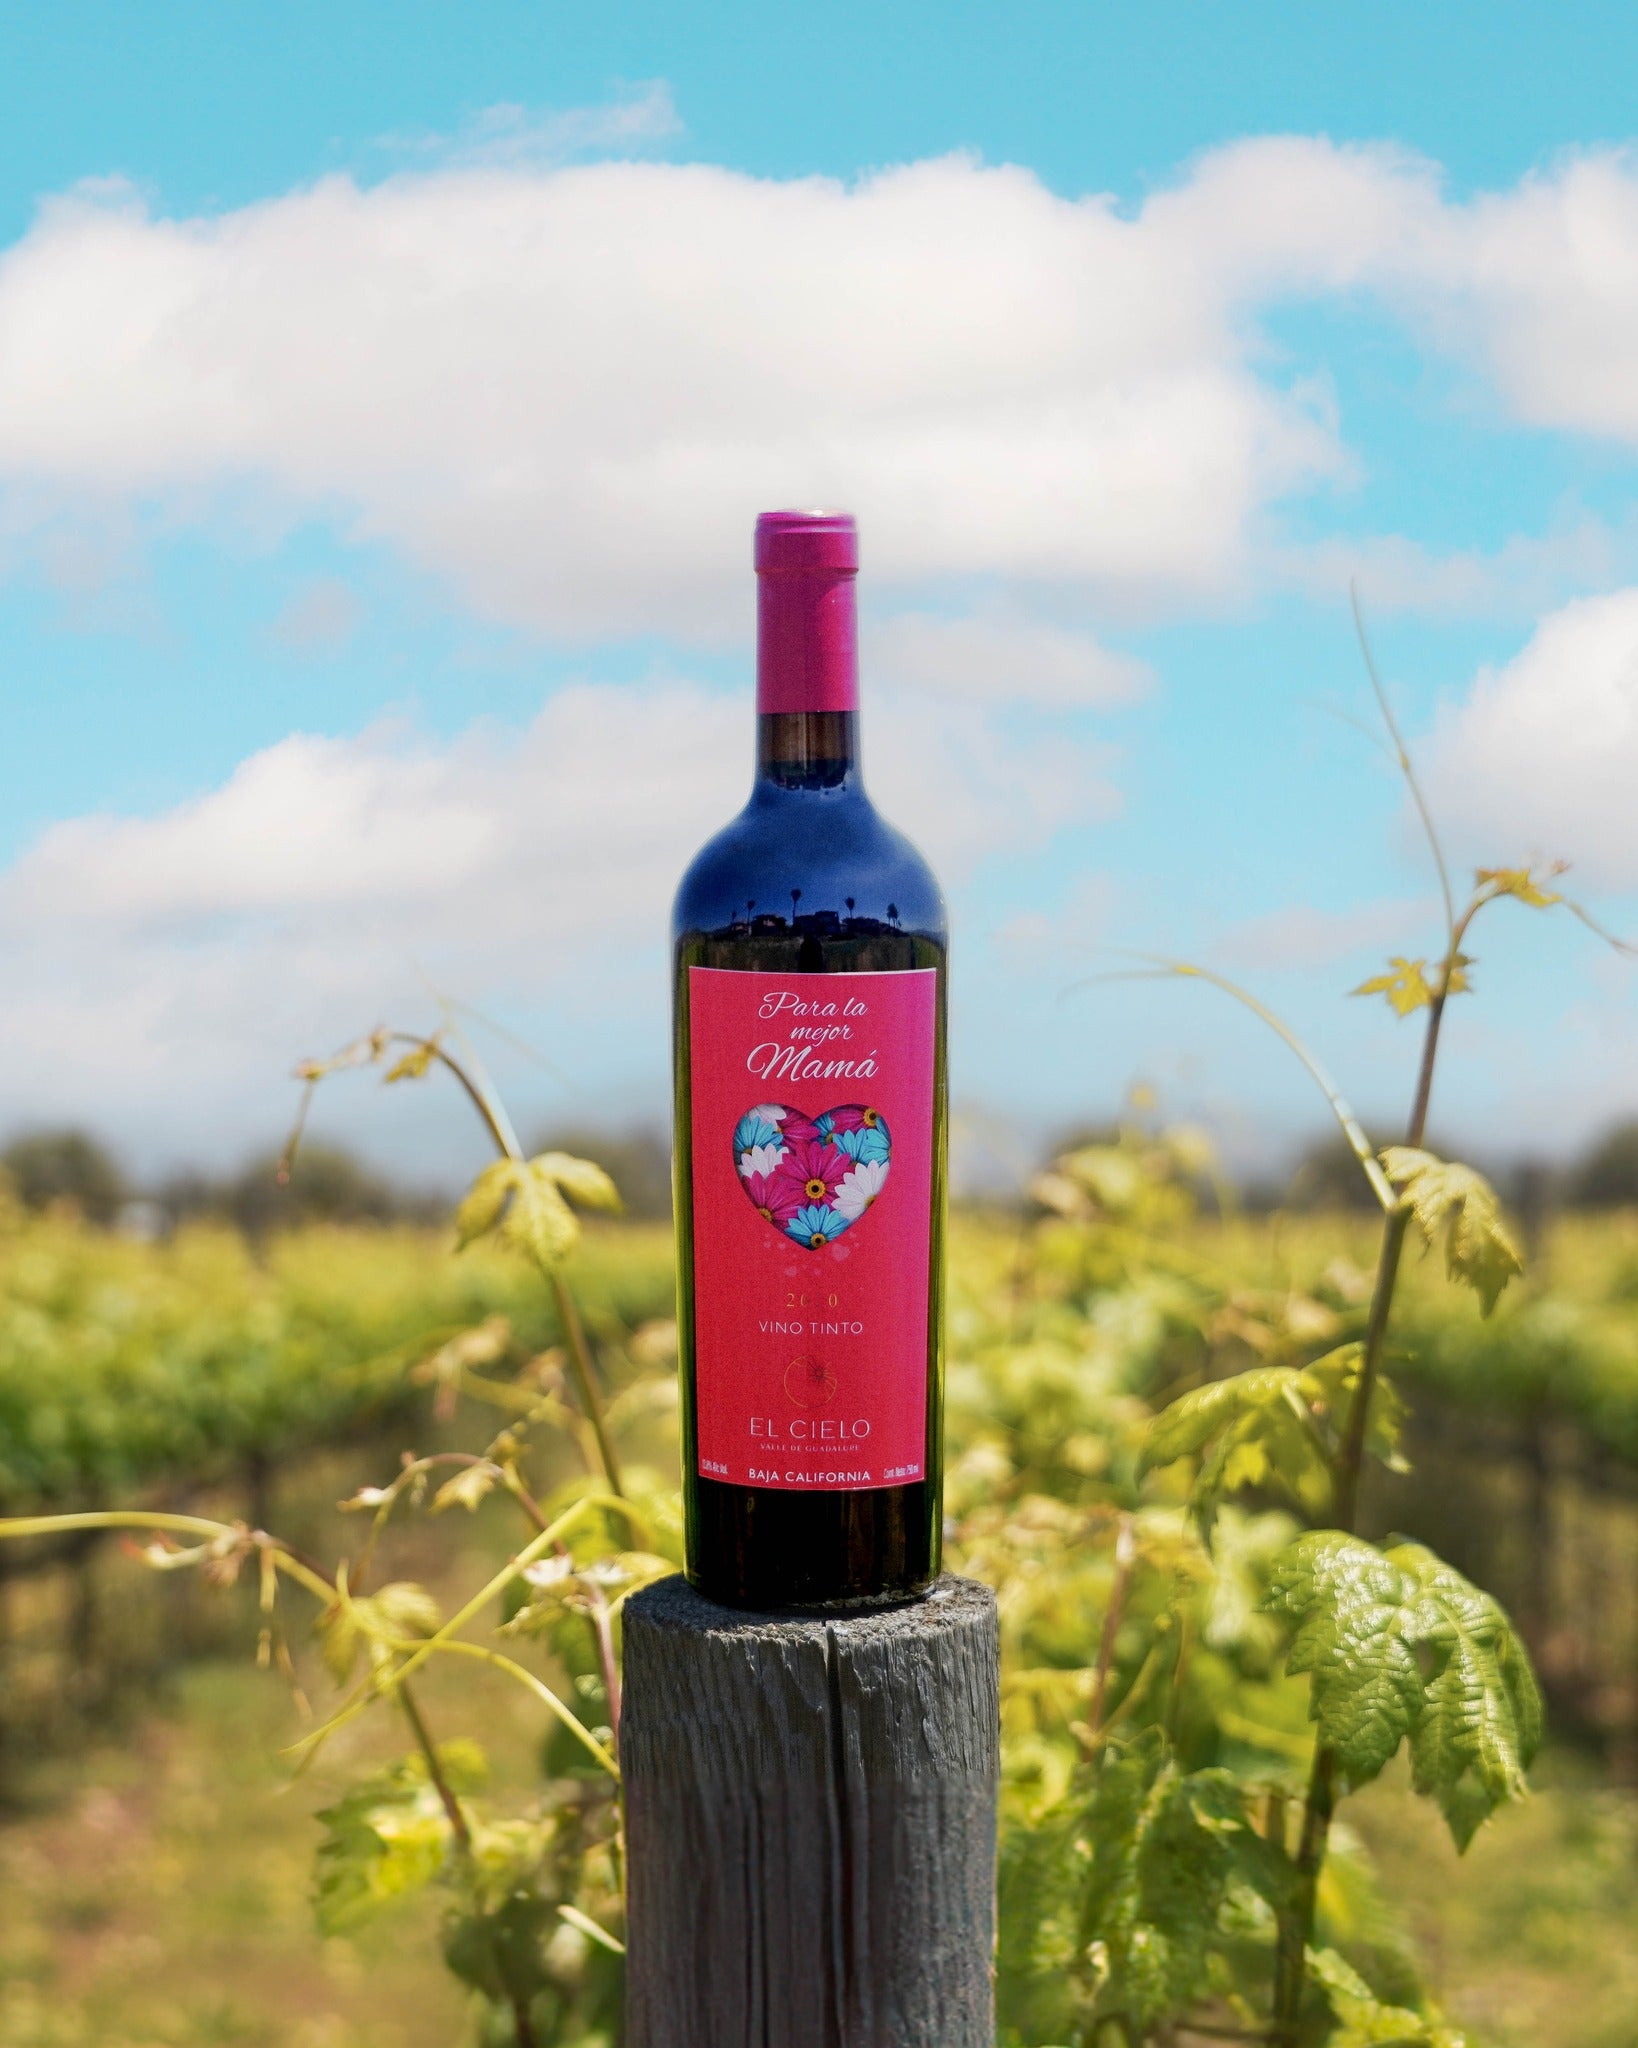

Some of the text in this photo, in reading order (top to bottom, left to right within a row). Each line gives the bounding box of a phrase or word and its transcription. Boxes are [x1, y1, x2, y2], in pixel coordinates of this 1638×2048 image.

[758, 991, 869, 1019] Para la
[790, 1024, 854, 1047] mejor
[746, 1042, 879, 1082] Mamá
[758, 1321, 863, 1335] VINO TINTO
[750, 1417, 870, 1439] EL CIELO
[805, 1444, 859, 1452] GUADALUPE
[748, 1468, 871, 1483] BAJA CALIFORNIA
